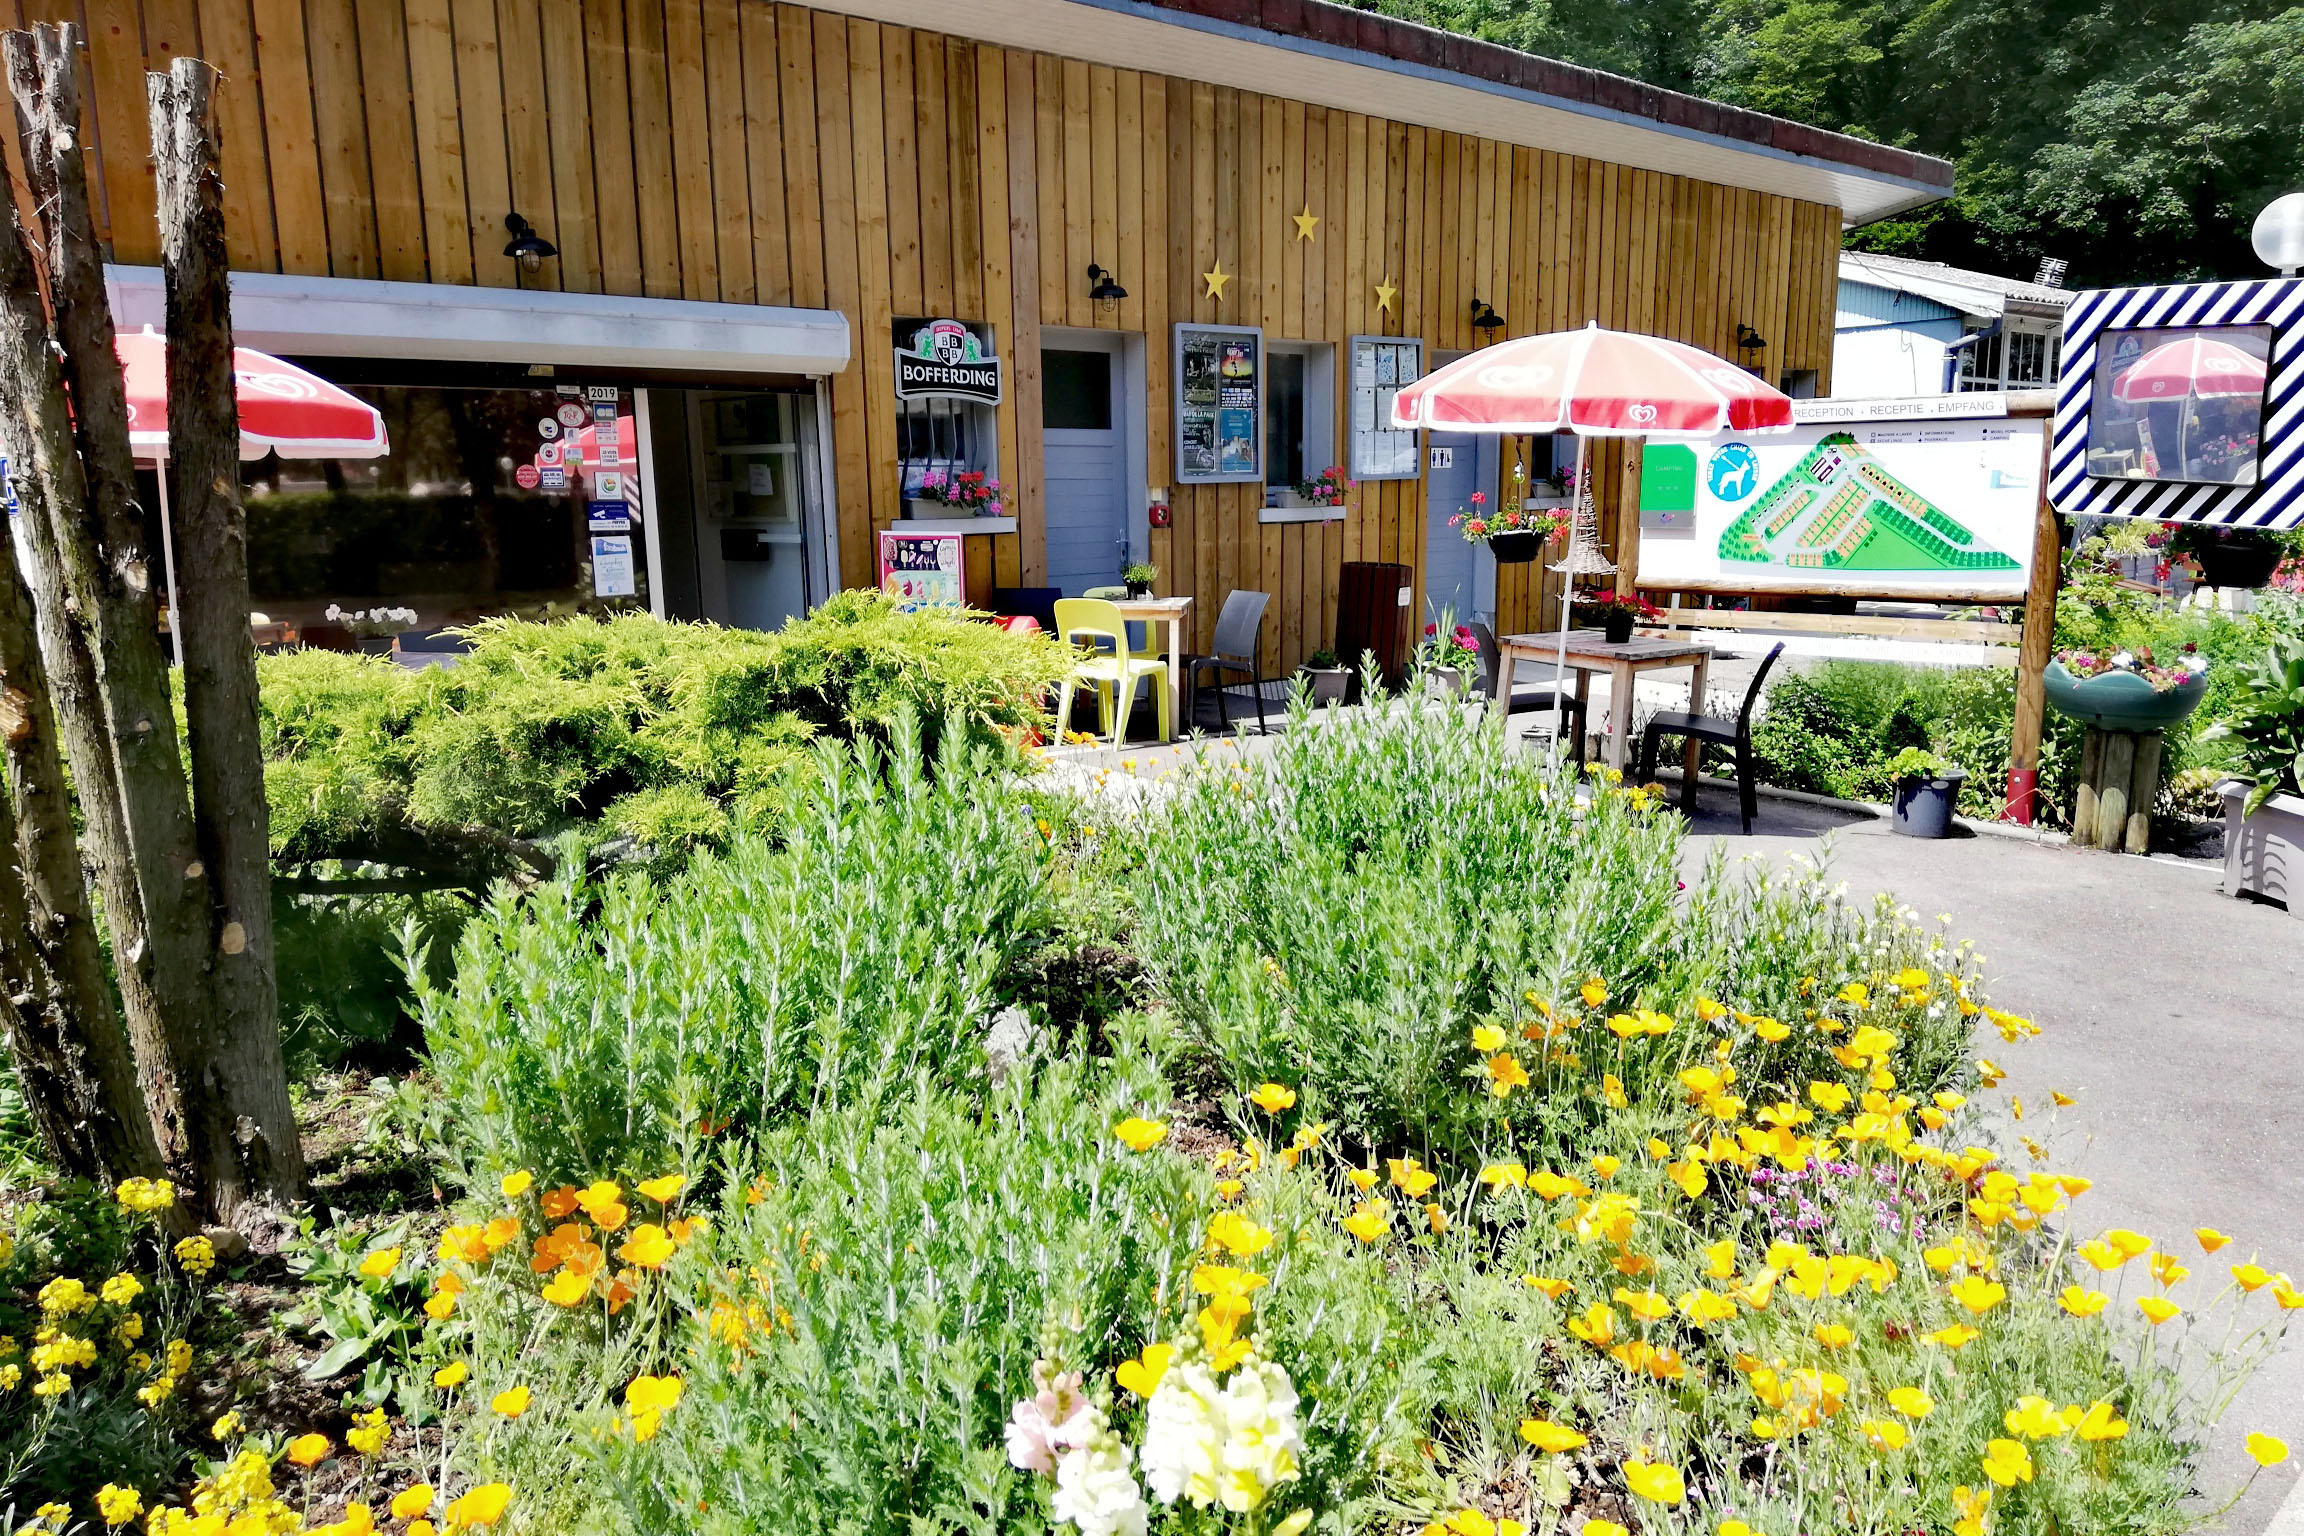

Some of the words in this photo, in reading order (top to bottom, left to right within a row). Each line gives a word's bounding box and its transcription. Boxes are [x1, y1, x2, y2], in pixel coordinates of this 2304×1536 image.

[903, 365, 996, 387] BOFFERDING
[590, 388, 616, 398] 2019
[1794, 406, 1854, 418] RECEPTION
[1870, 404, 1924, 416] RECEPTIE
[1938, 400, 1995, 413] EMPFANG
